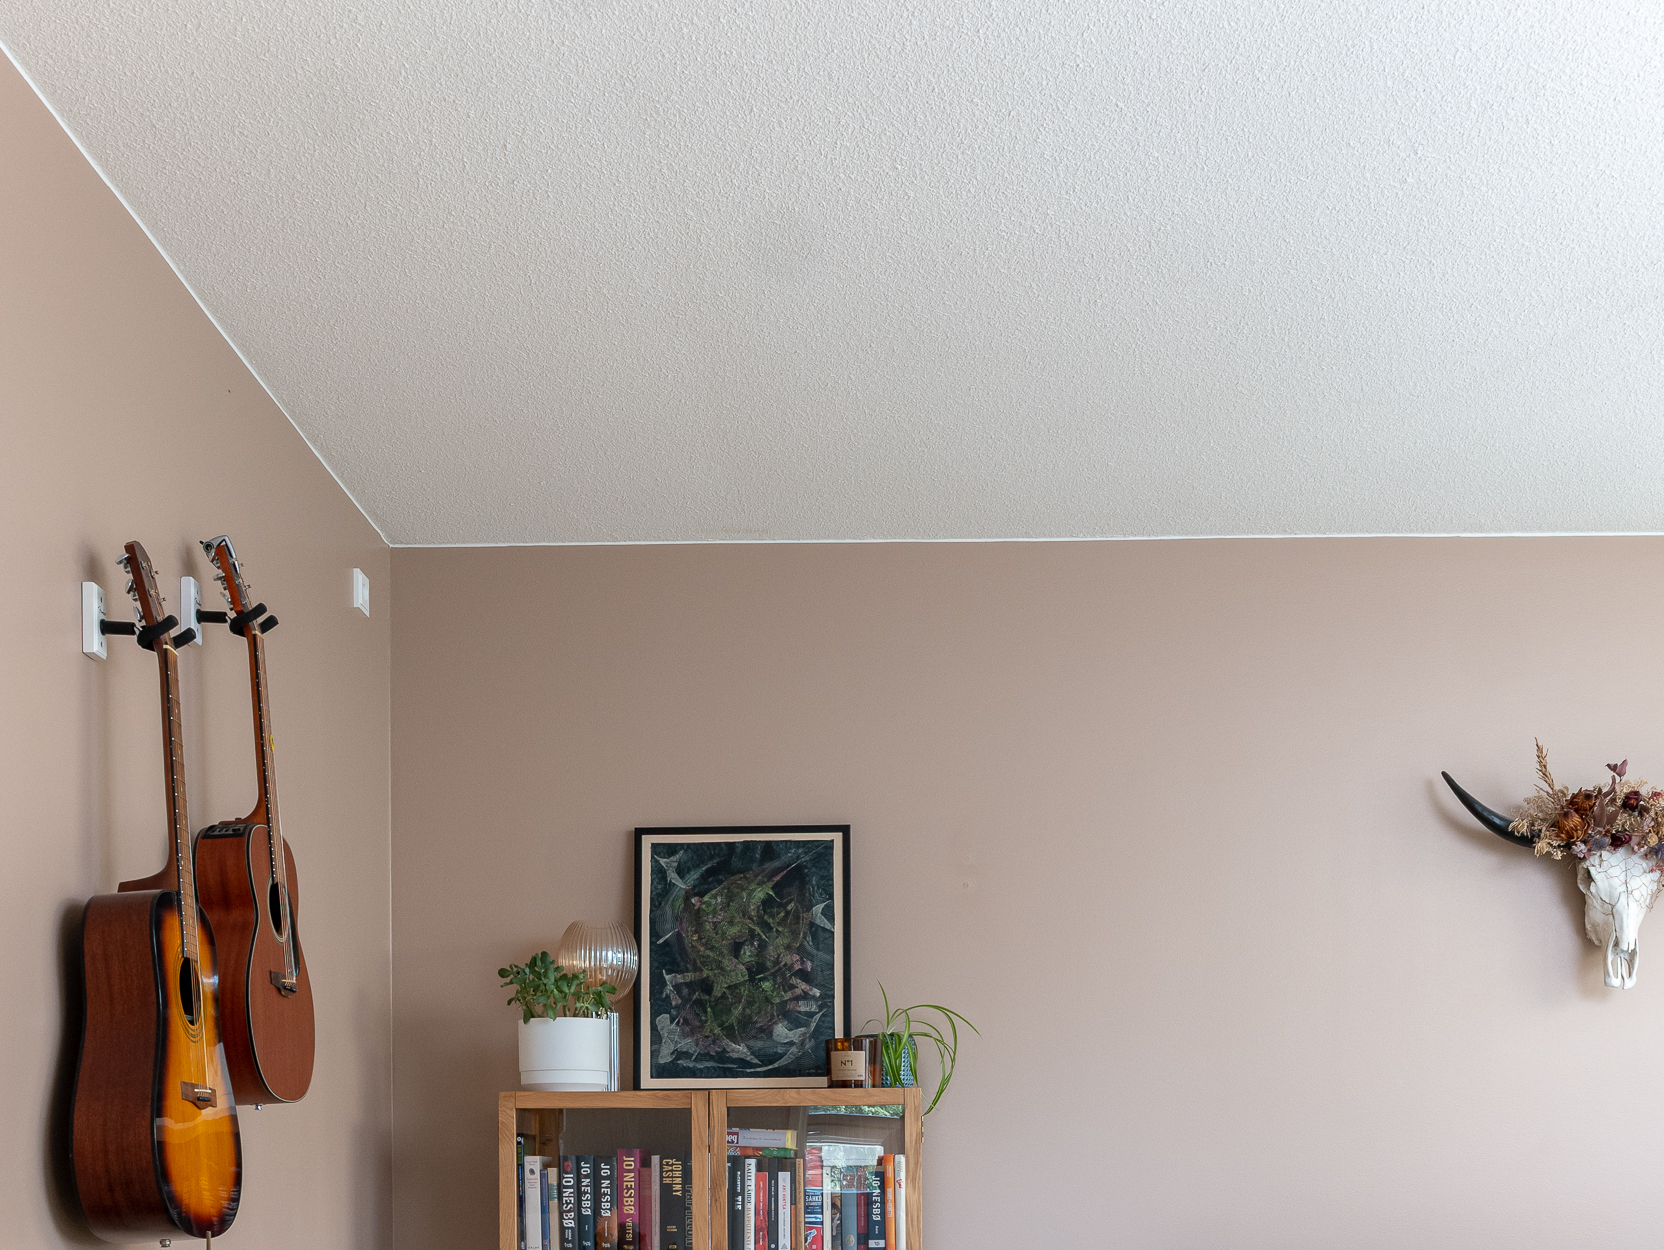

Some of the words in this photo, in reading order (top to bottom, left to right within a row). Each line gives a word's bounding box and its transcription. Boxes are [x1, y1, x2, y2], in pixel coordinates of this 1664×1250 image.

[580, 1161, 591, 1176] JO
[600, 1163, 611, 1177] JO
[622, 1155, 635, 1170] JO
[662, 1158, 673, 1184] CASH
[672, 1158, 682, 1197] JOHNNY
[562, 1188, 576, 1228] NESBØ
[580, 1178, 592, 1216] NESBØ
[600, 1179, 612, 1217] NESBØ
[622, 1172, 636, 1215] NESBØ
